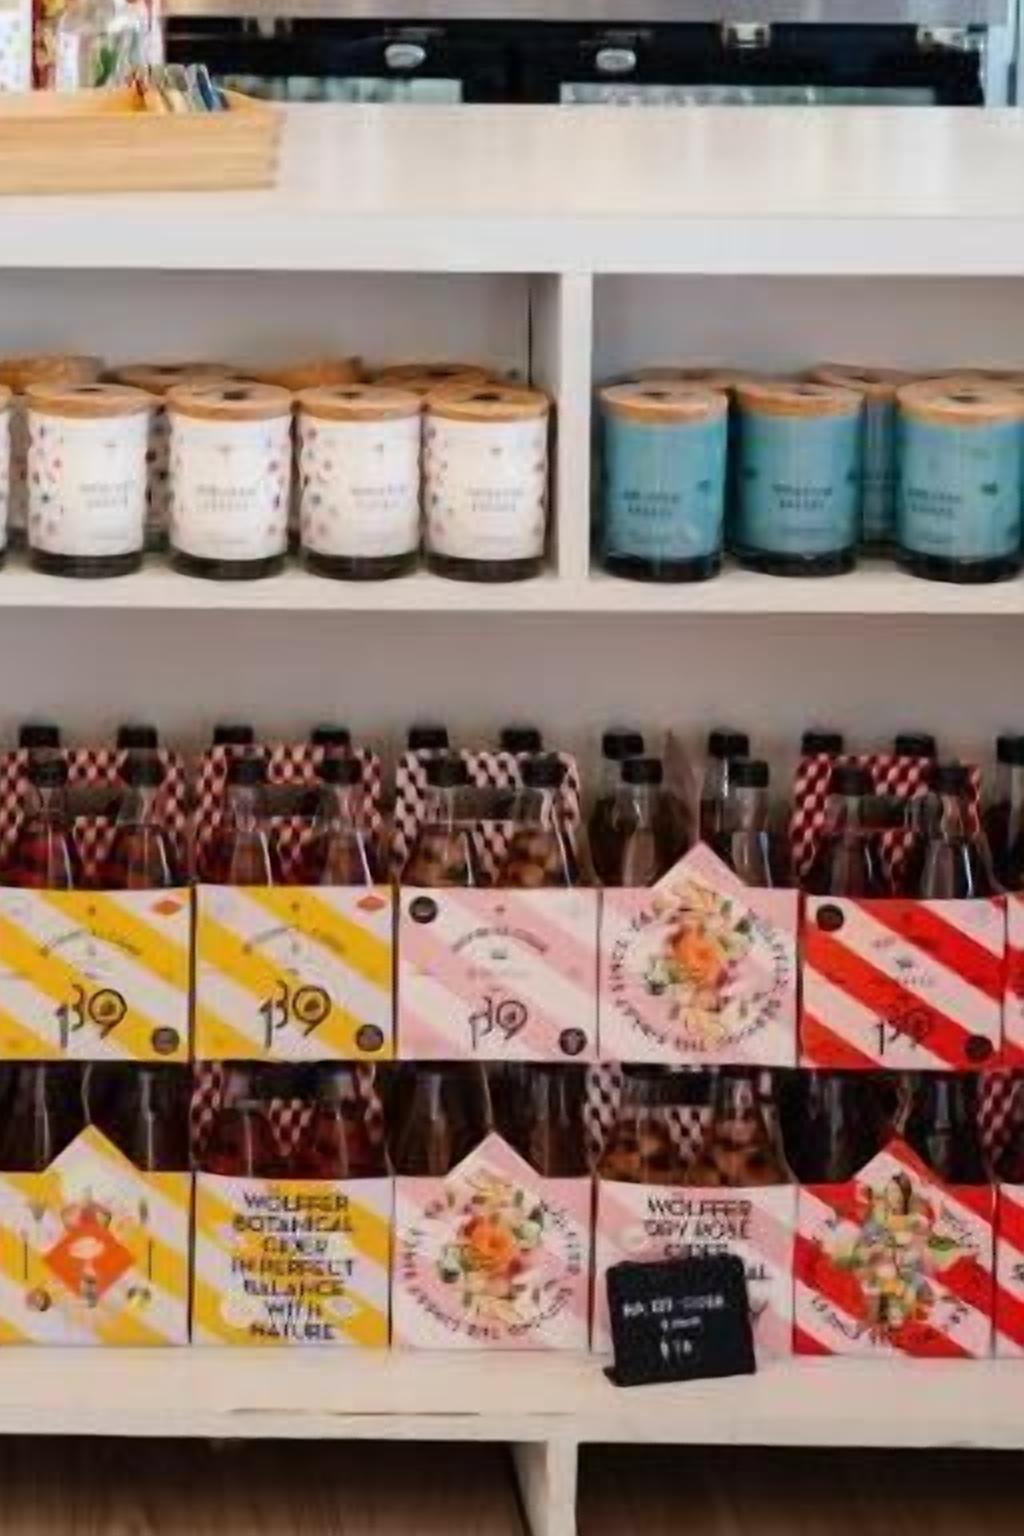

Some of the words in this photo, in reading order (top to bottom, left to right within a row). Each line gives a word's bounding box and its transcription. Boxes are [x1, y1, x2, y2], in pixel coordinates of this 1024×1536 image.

[233, 1214, 353, 1233] BOTANICAL
[259, 1259, 353, 1277] PERFECT
[243, 1278, 345, 1296] BALANCE
[249, 1321, 335, 1340] NATURE
